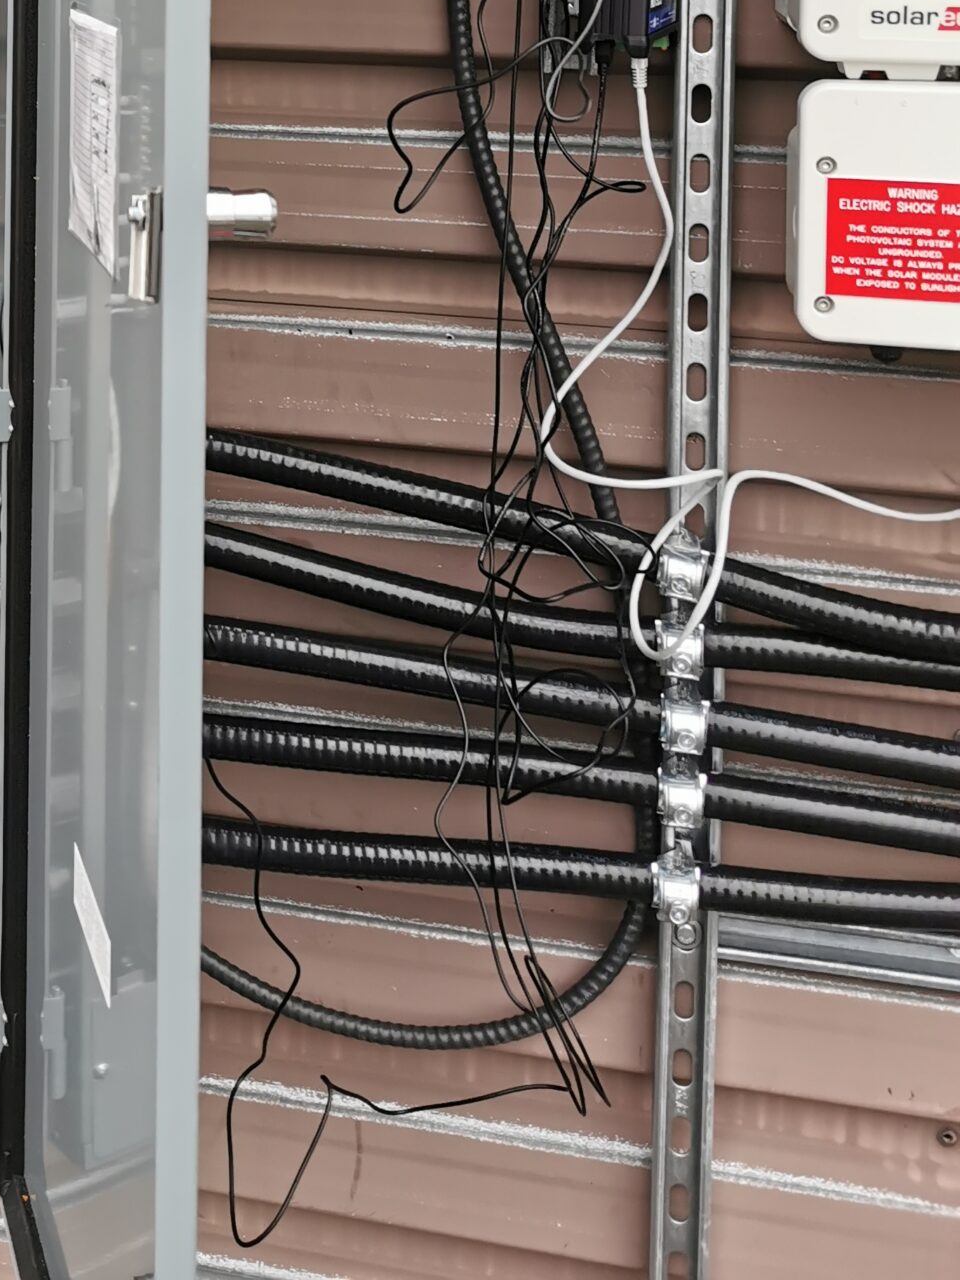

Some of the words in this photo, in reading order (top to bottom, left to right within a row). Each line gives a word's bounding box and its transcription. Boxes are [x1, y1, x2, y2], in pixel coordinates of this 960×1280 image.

[887, 187, 939, 200] WARNING
[839, 198, 891, 212] ELECTRIC
[896, 201, 936, 214] SHOCK
[848, 224, 866, 233] THE
[870, 225, 933, 236] CONDUCTORS
[937, 228, 951, 237] OF
[846, 234, 912, 246] PHOTOVOLTAIC
[916, 239, 954, 248] SYSTEM
[831, 255, 845, 264] DC
[849, 257, 889, 267] VOLTAGE
[893, 259, 903, 267] IS
[907, 260, 944, 270] ALWAYS
[832, 267, 860, 275] WHEN
[865, 268, 883, 277] THE
[887, 270, 917, 279] SOLAR
[856, 278, 900, 289] EXPOSED
[904, 281, 916, 290] TO
